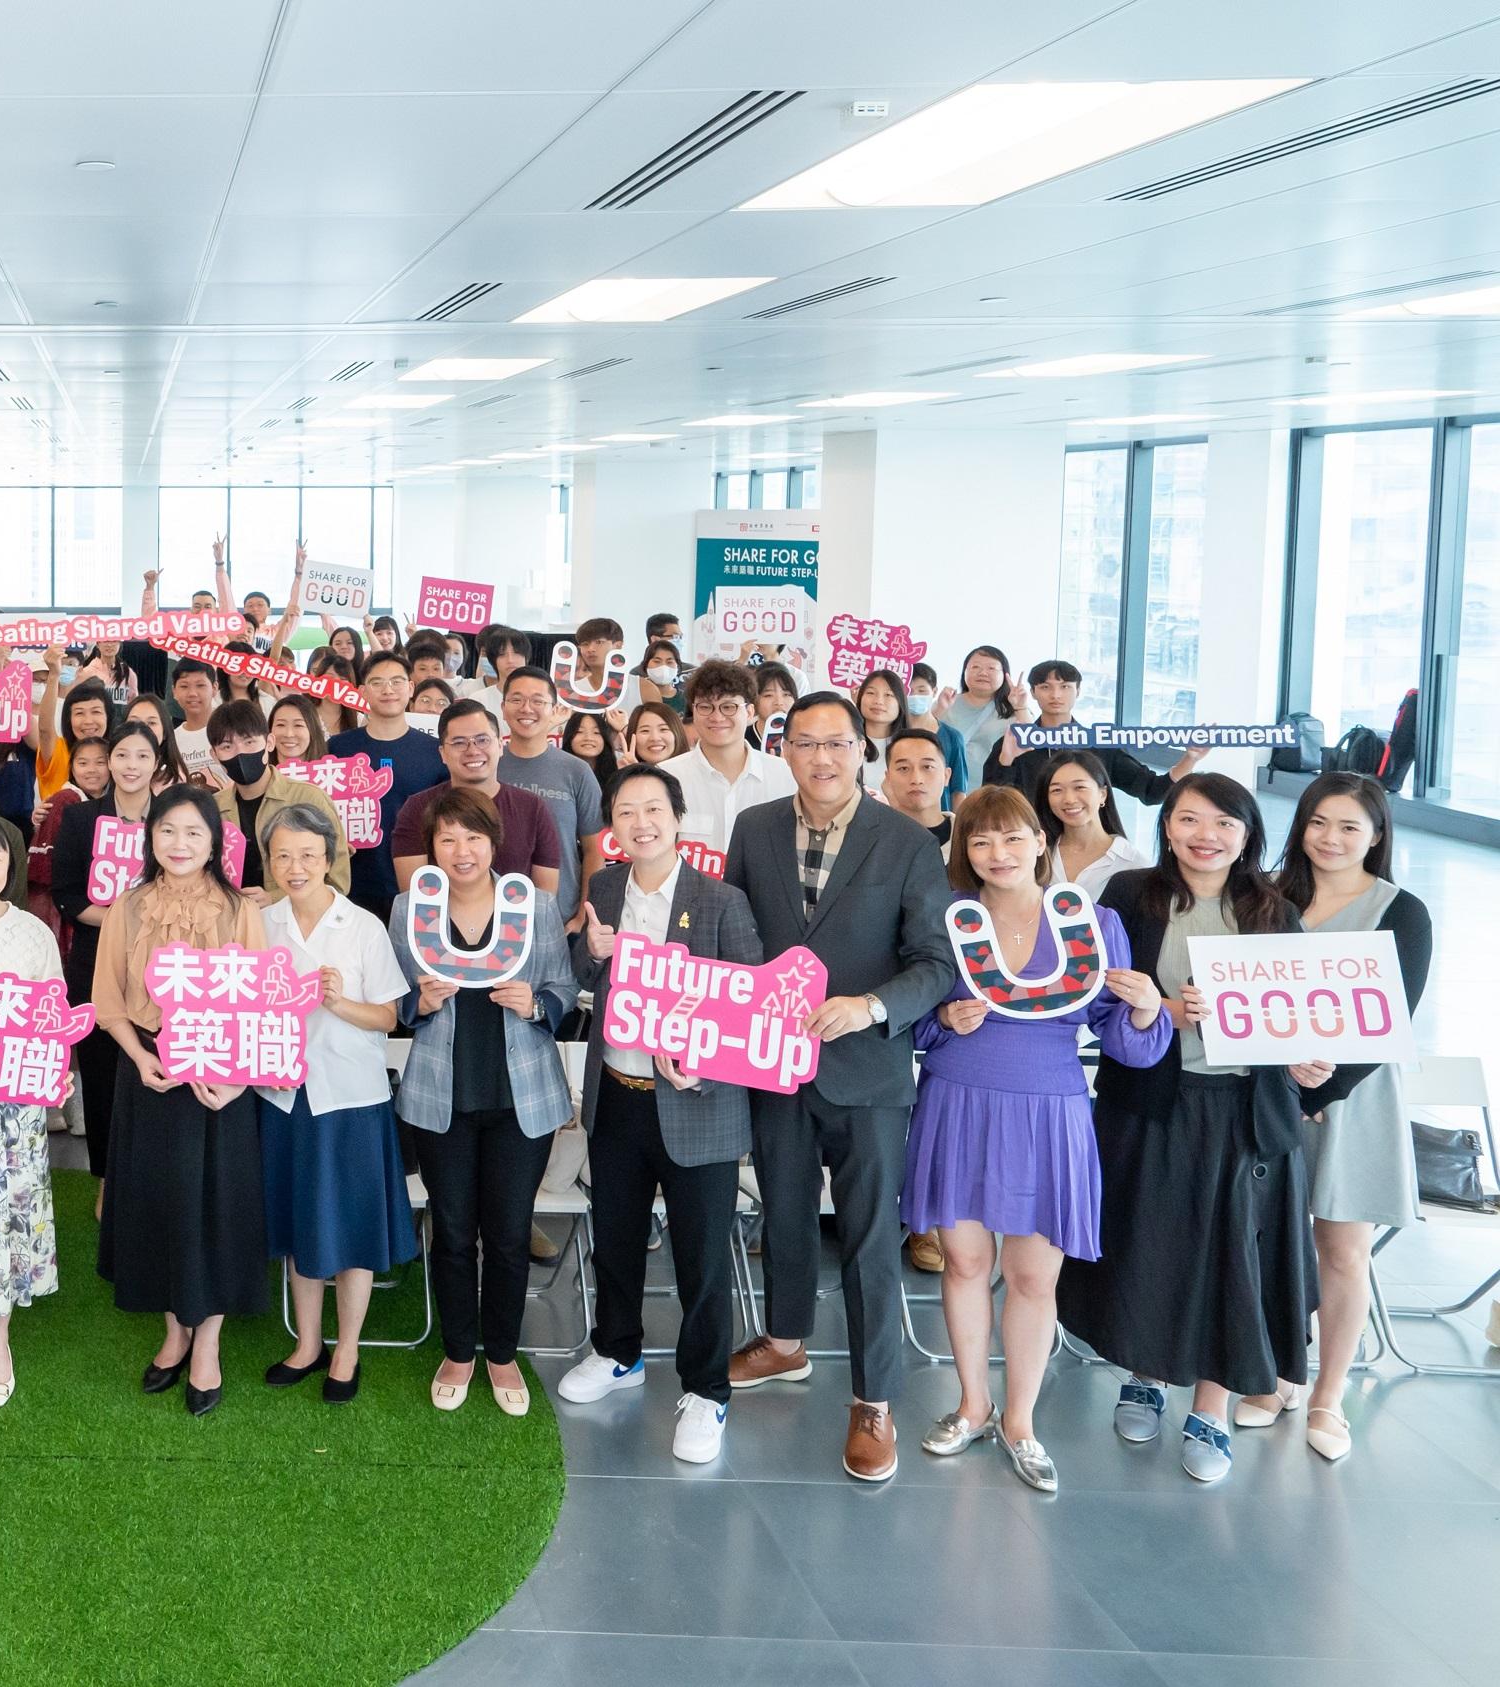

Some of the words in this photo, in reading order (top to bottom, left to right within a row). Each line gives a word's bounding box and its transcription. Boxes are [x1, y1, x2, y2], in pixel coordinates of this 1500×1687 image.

[723, 547, 766, 563] SHARE
[771, 548, 799, 564] FOR
[308, 570, 342, 584] SHARE
[346, 576, 367, 588] FOR
[756, 566, 788, 577] FUTURE
[305, 582, 366, 609] GOOD
[426, 586, 461, 601] SHARE
[465, 592, 487, 603] FOR
[723, 598, 765, 608] SHARE
[770, 598, 796, 608] FOR
[423, 598, 487, 625] GOOD
[723, 611, 796, 633] GOOD
[73, 615, 164, 640] Shared
[169, 612, 243, 634] Value
[830, 617, 891, 652] 未來
[246, 656, 328, 695] Shared
[1015, 725, 1088, 746] Youth
[1095, 723, 1296, 749] Empowerment
[332, 796, 379, 843] 職
[98, 820, 146, 860] Fut
[153, 947, 259, 1004] 未來
[617, 938, 754, 1005] Future
[1211, 959, 1307, 983] SHARE
[1321, 958, 1382, 980] FOR
[1216, 987, 1392, 1040] GOOD
[167, 1007, 303, 1081] 築職
[609, 989, 813, 1088] Step-Up
